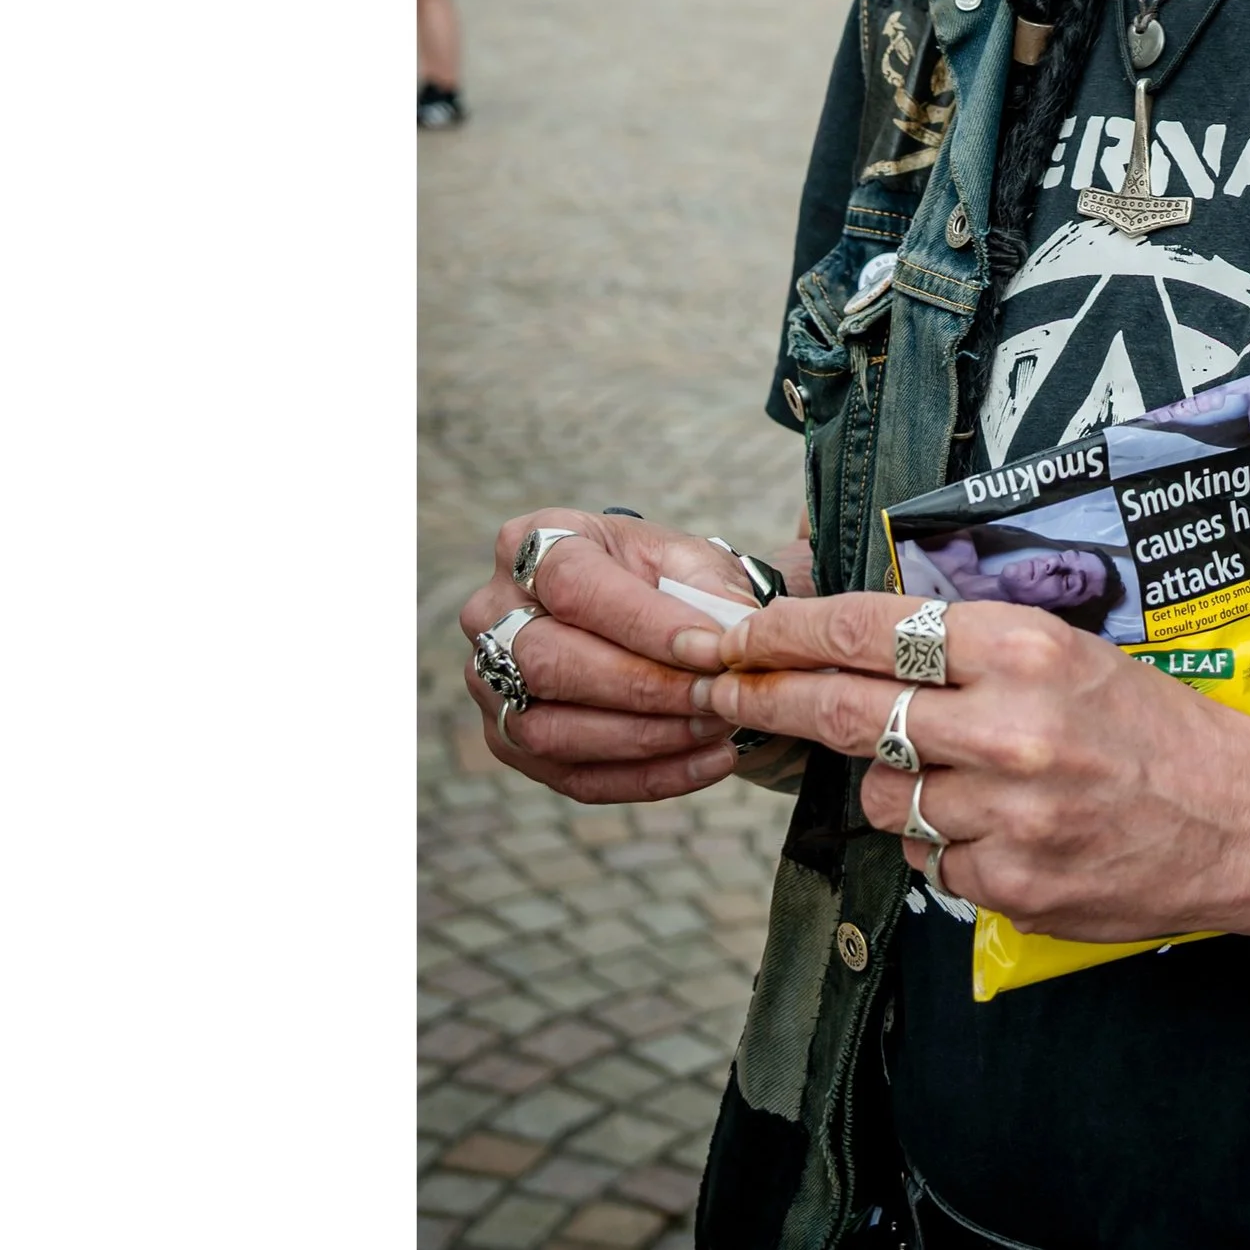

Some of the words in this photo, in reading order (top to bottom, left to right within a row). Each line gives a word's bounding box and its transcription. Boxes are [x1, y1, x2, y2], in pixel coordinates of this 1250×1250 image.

[964, 445, 1104, 505] Smoking
[1121, 464, 1250, 522] Smoking
[1135, 512, 1225, 564] causes
[1145, 552, 1245, 606] attacks
[1152, 611, 1172, 622] Get
[1174, 602, 1197, 619] help
[1199, 599, 1209, 611] to
[1211, 592, 1231, 607] stop
[1154, 620, 1193, 637] consult
[1195, 612, 1222, 631] your
[1219, 603, 1249, 620] doctor
[1168, 652, 1228, 674] LEAF
